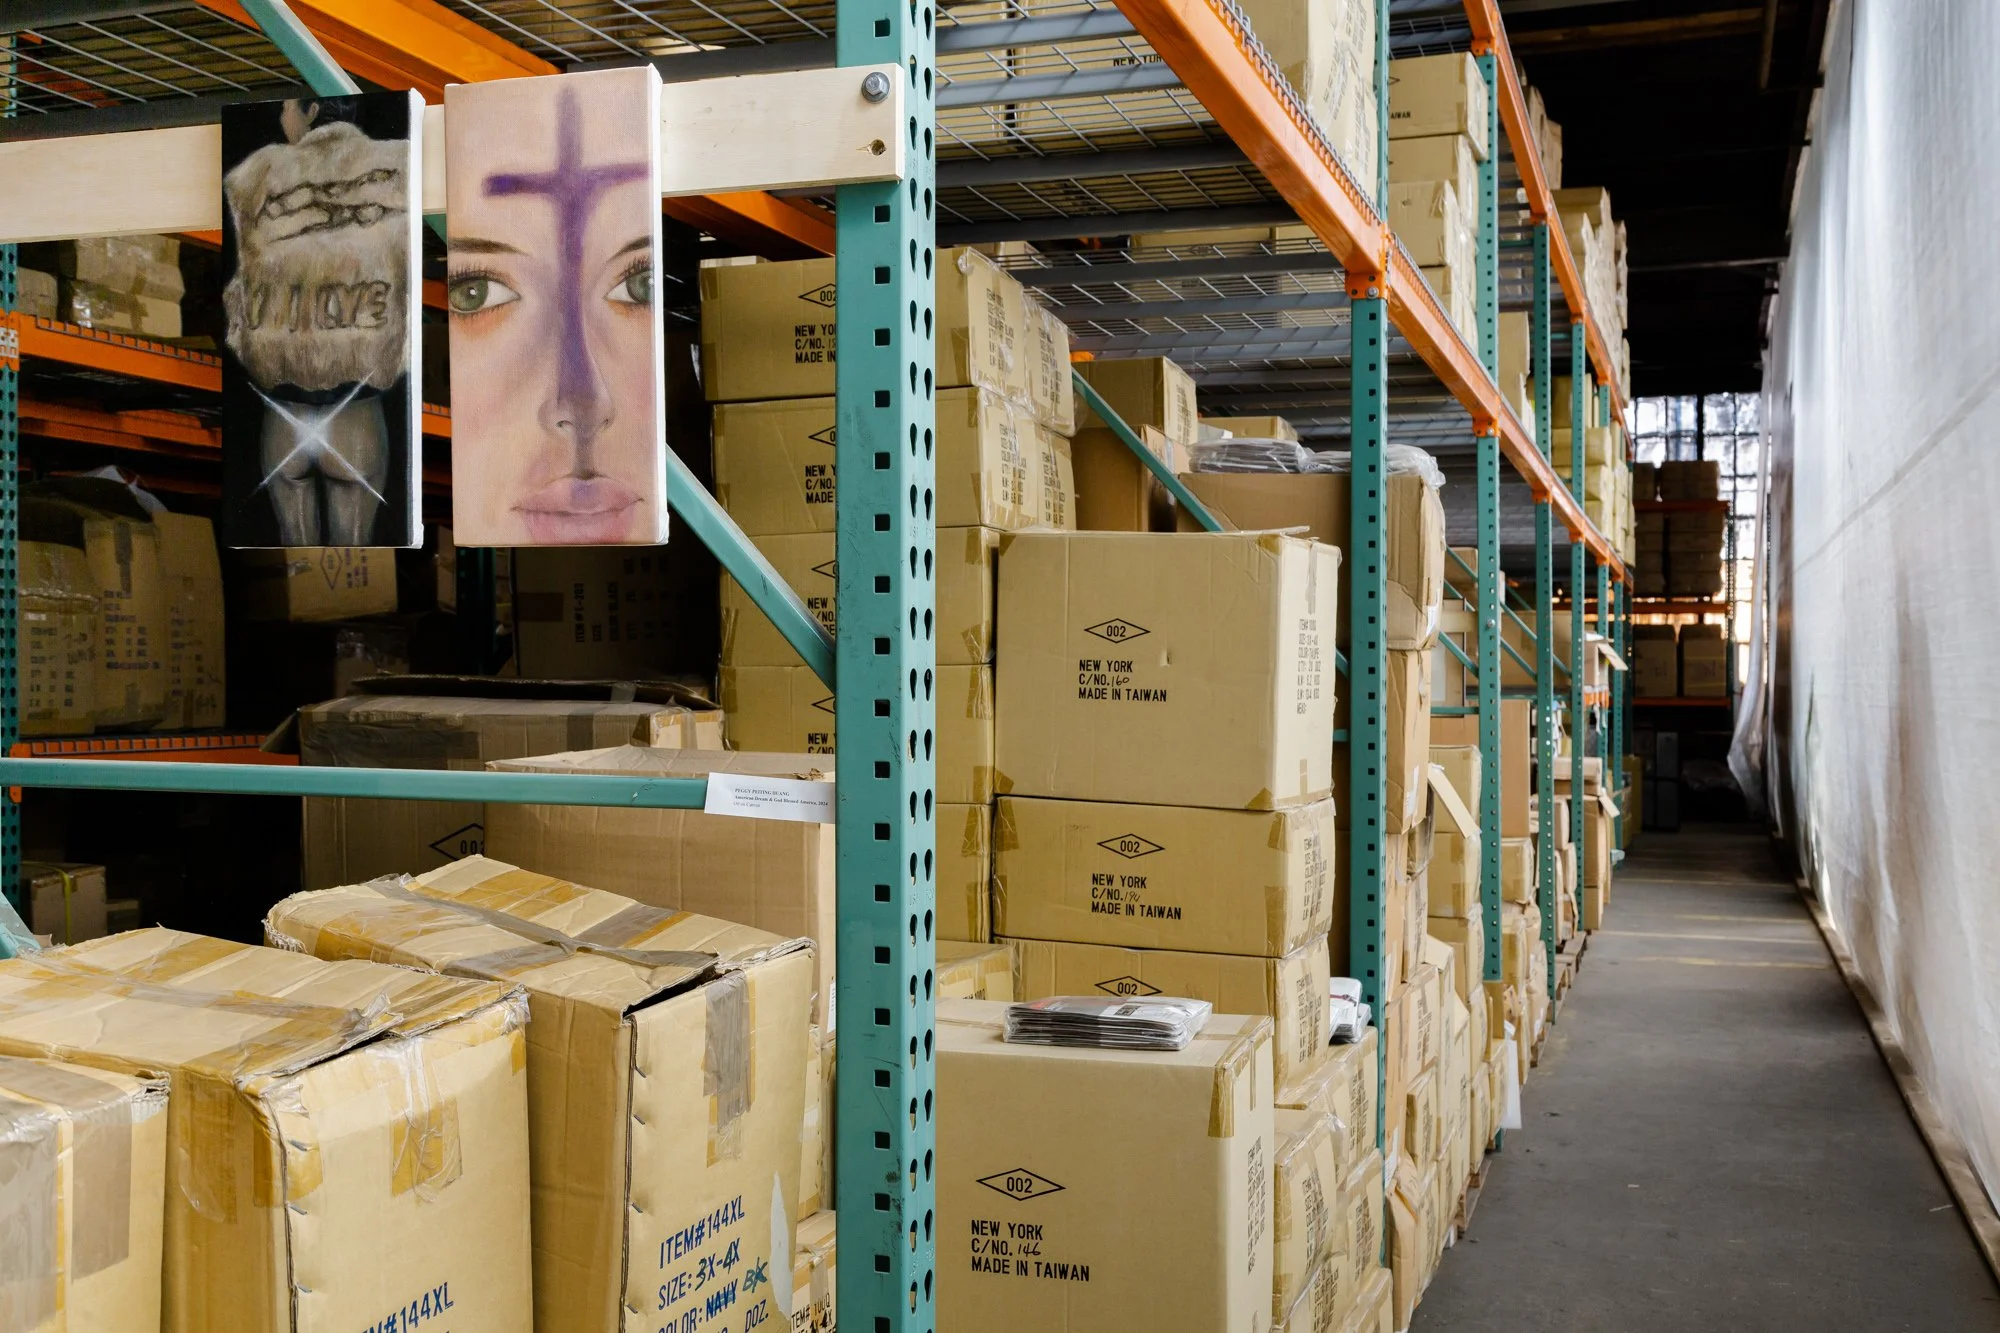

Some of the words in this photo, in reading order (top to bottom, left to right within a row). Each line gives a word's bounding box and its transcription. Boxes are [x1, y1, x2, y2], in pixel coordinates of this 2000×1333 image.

[795, 324, 816, 337] NEW
[795, 338, 825, 350] C/NO.
[795, 351, 823, 364] MADE
[805, 464, 826, 477] NEW
[805, 478, 835, 490] C/NO.
[805, 491, 834, 504] MADE
[807, 597, 828, 609] NEW
[1106, 625, 1126, 638] 002
[1079, 659, 1102, 672] NEW
[1106, 660, 1133, 673] YORK
[1079, 673, 1110, 686] C/NO.
[1079, 688, 1108, 700] MADE
[1112, 688, 1121, 701] IN
[1126, 689, 1167, 702] TAIWAN
[807, 732, 829, 745] NEW
[1120, 839, 1140, 853] 002
[1091, 873, 1114, 886] NEW
[1120, 875, 1147, 889] YORK
[1091, 887, 1123, 901] C/NO.
[1091, 901, 1121, 915] MADE
[1125, 903, 1135, 916] IN
[1140, 904, 1182, 920] TAIWAN
[1117, 982, 1138, 995] 002
[1006, 1176, 1033, 1194] 002
[971, 1219, 1000, 1237] NEW
[1008, 1222, 1044, 1241] YORK
[971, 1238, 1013, 1257] C/NO.
[971, 1256, 1010, 1275] MADE
[1016, 1259, 1028, 1277] IN
[1034, 1261, 1090, 1282] TAIWAN
